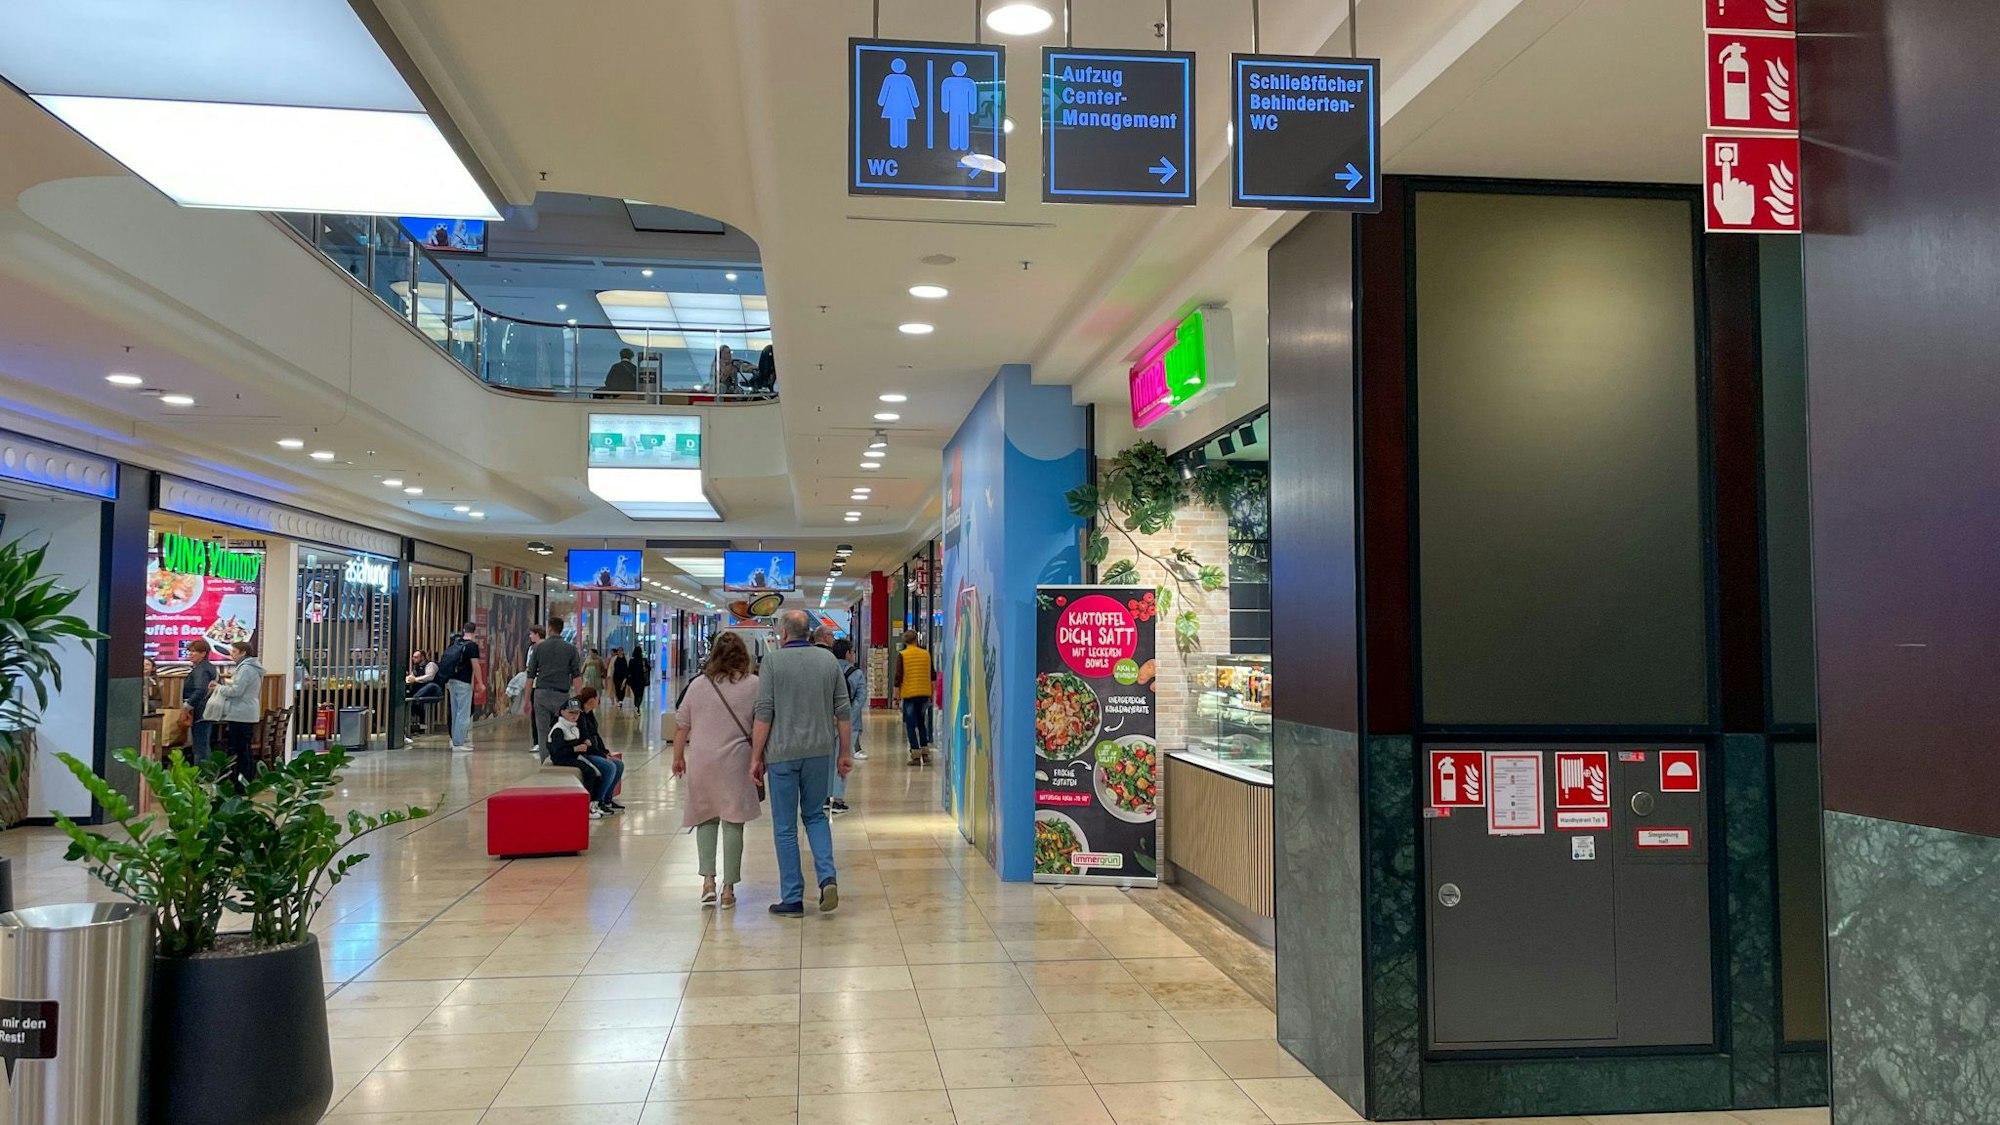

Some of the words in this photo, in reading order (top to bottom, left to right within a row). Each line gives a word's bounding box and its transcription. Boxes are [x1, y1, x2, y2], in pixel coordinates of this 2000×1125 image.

[1062, 65, 1122, 87] Aufzug
[1249, 72, 1363, 92] Schließfächer
[1062, 87, 1127, 105] Center-
[1250, 93, 1355, 112] Behinderten-
[1062, 109, 1177, 131] Management
[1249, 113, 1279, 131] WC
[867, 158, 898, 177] WC
[208, 540, 262, 581] Yummy
[1069, 612, 1125, 626] KARTOFFEL
[181, 624, 206, 636] Box
[1099, 628, 1135, 645] SATT
[1072, 647, 1086, 657] MIT
[1088, 647, 1122, 657] LECKEREN
[1085, 658, 1109, 669] BOWLS
[1053, 769, 1075, 778] FRISCHE
[1052, 778, 1077, 787] ZUTATEN
[2, 1016, 20, 1028] mir
[22, 1018, 46, 1029] den
